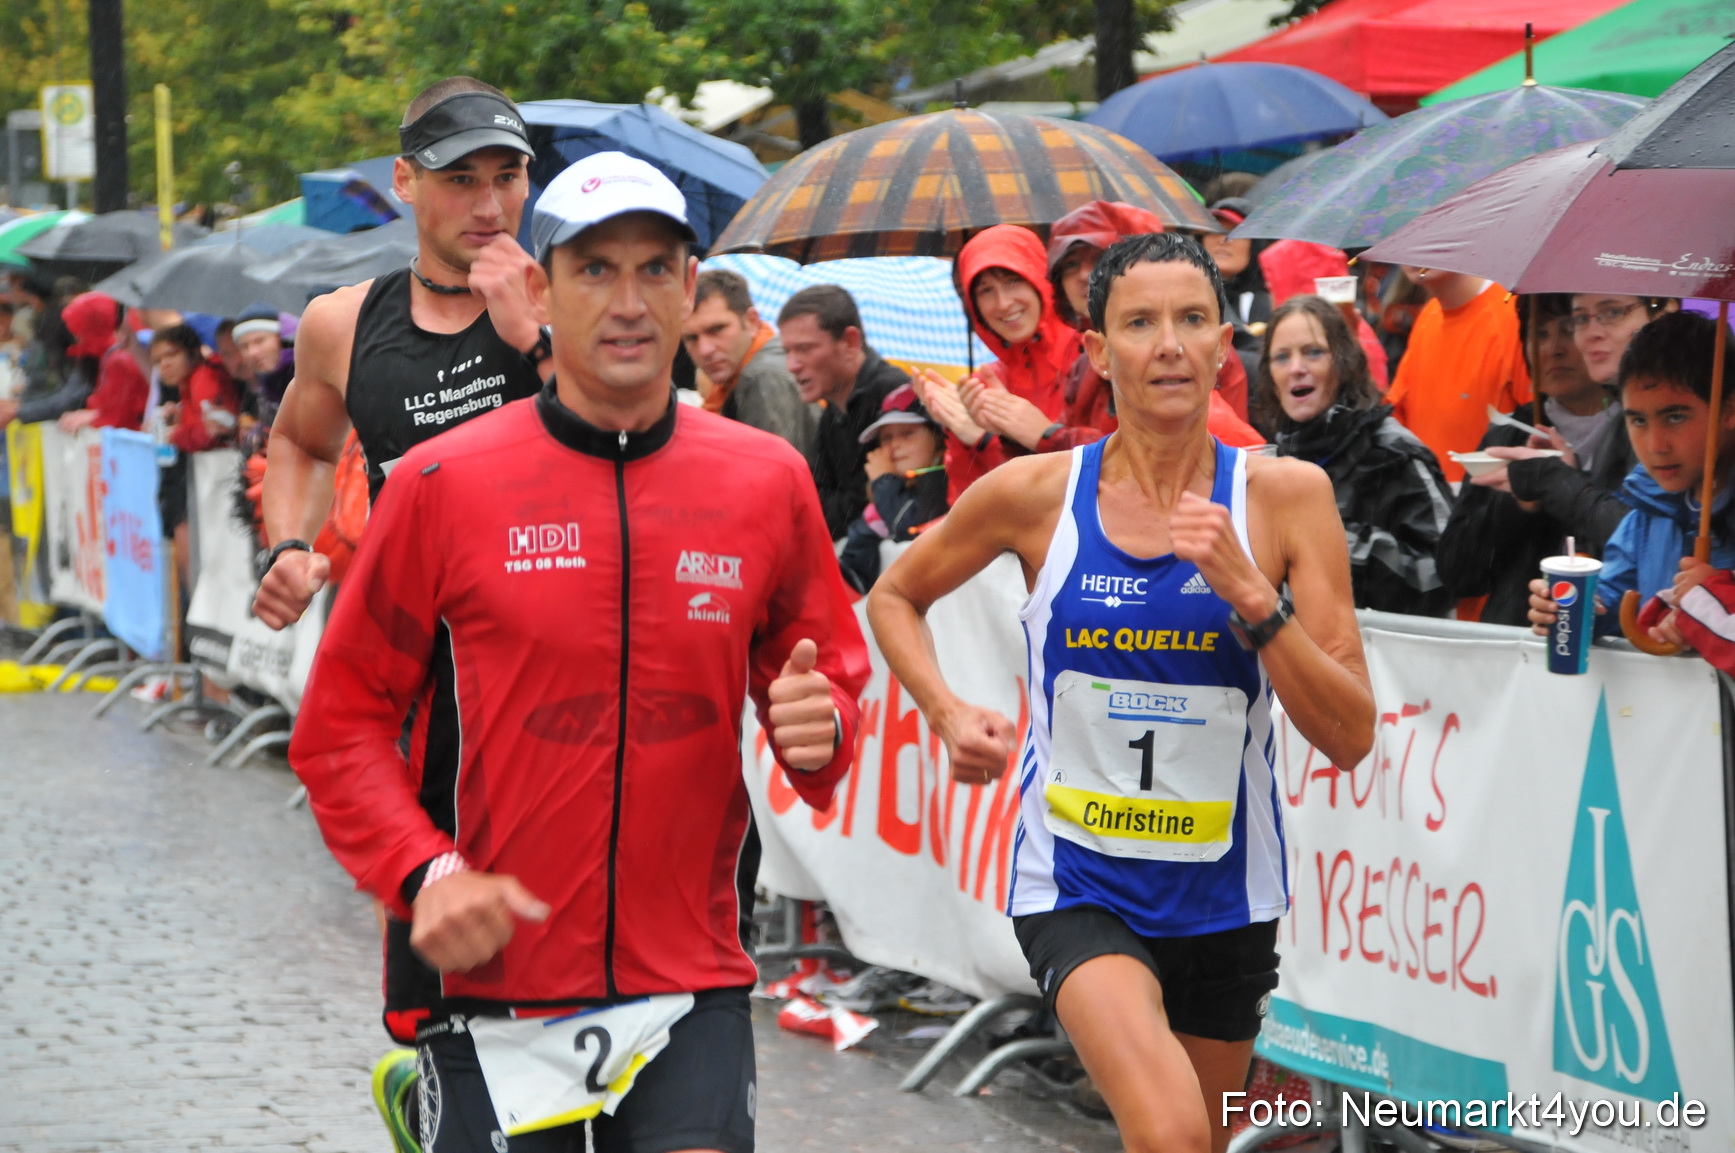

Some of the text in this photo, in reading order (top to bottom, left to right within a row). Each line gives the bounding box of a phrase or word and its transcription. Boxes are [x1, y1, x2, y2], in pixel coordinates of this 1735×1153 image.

[494, 114, 522, 131] 2XU
[423, 149, 438, 162] 2XU
[1671, 252, 1731, 272] Endres
[404, 374, 506, 411] LLC Marathon
[413, 393, 502, 426] Regensburg
[509, 522, 580, 557] HDI
[504, 556, 587, 574] TSG 08 Roth
[676, 549, 743, 580] ARNDT
[1081, 573, 1149, 596] HEITEC
[1180, 586, 1212, 595] adidas
[687, 608, 730, 624] skinfit
[1065, 627, 1220, 653] LAC QUELLE
[1556, 609, 1573, 657] pepsi
[1108, 691, 1188, 713] BOCK
[1128, 729, 1156, 791] 1
[1054, 771, 1063, 783] A
[1083, 801, 1195, 836] Christine
[1316, 849, 1497, 999] BESSER.
[573, 1026, 613, 1095] 2
